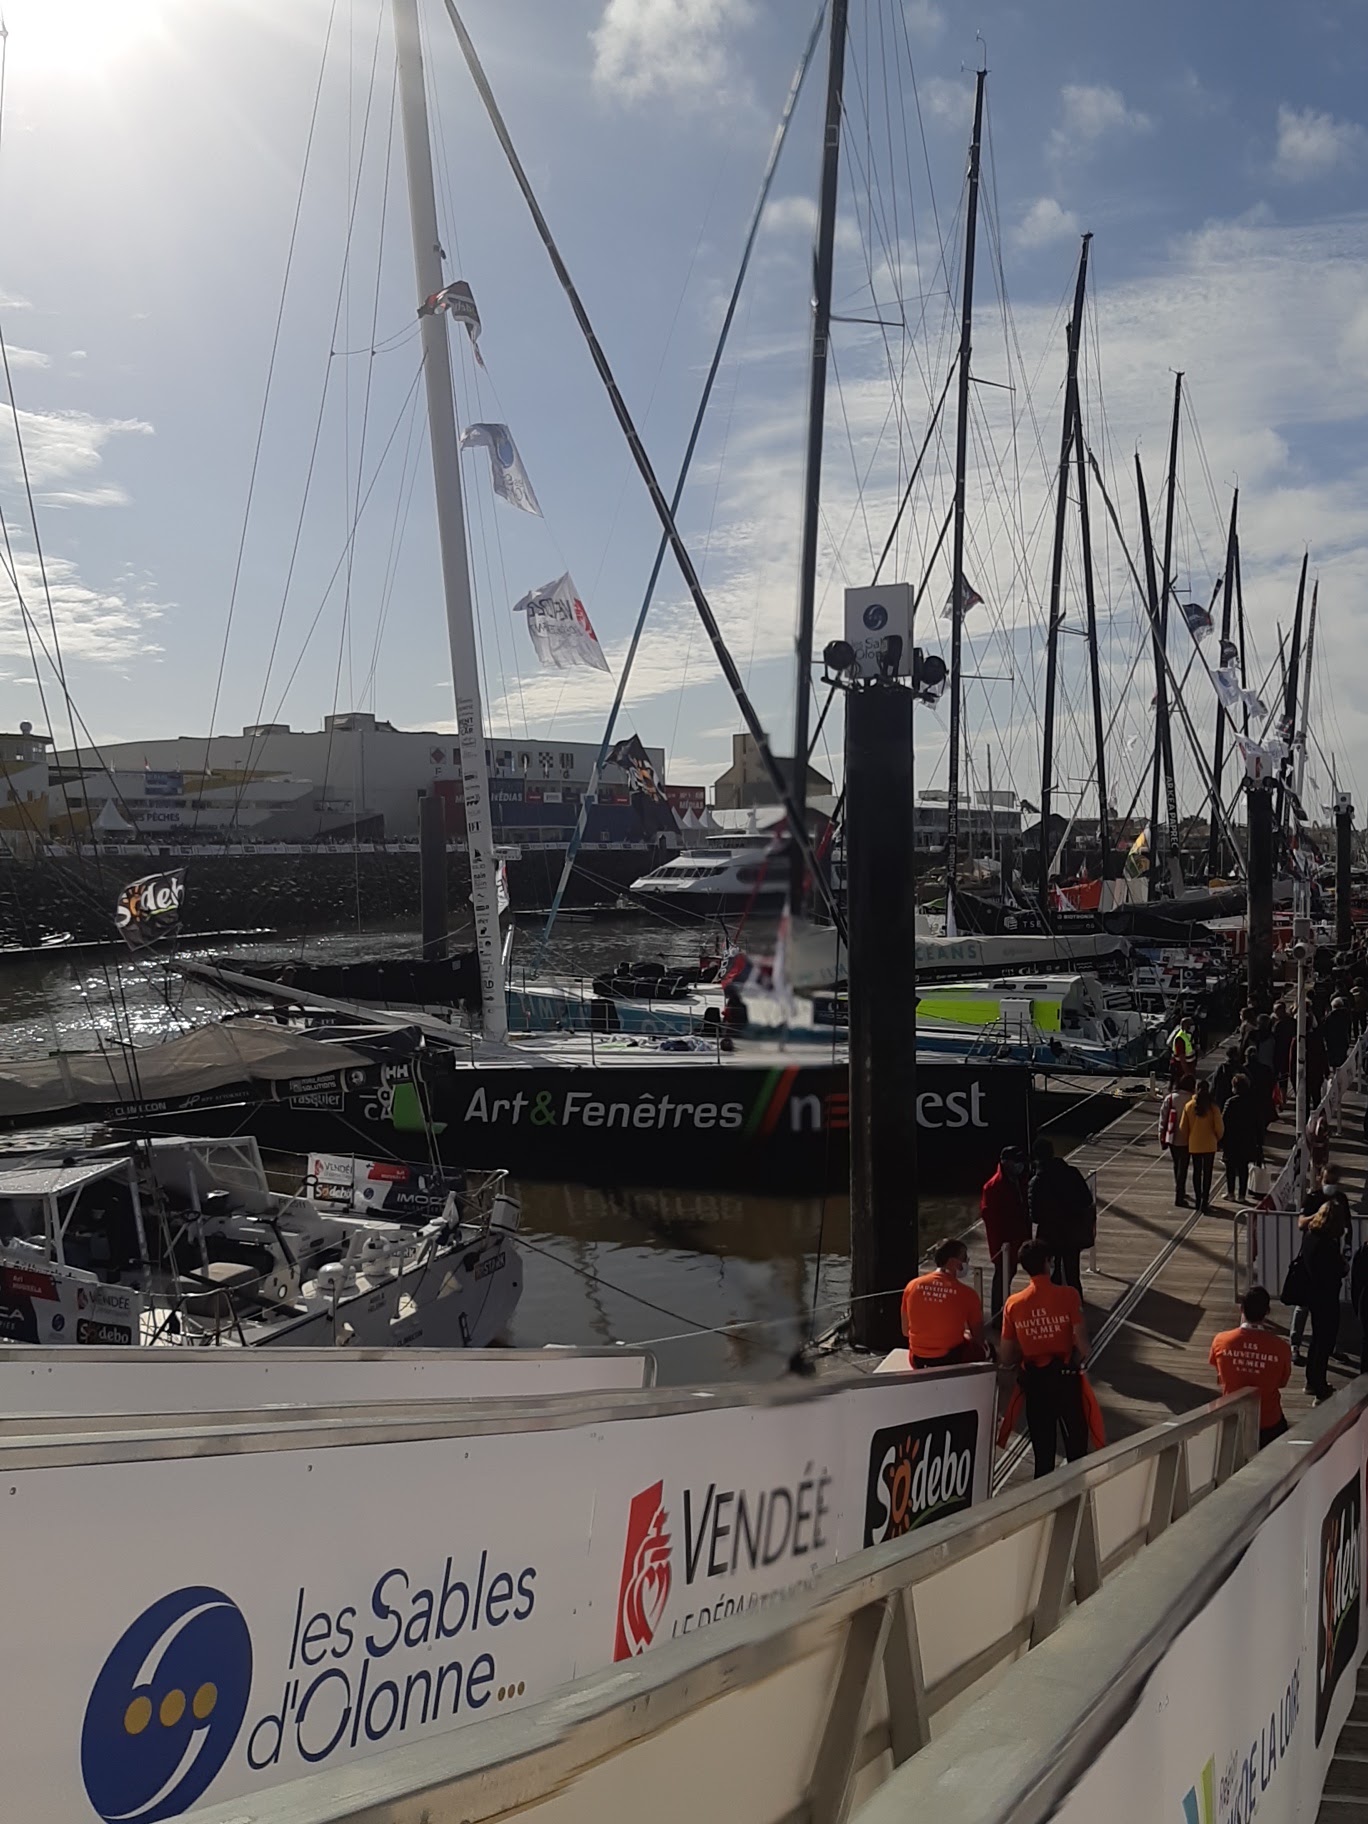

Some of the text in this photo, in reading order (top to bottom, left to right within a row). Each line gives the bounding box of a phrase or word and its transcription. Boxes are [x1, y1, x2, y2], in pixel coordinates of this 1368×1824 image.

[1031, 1307, 1047, 1318] LES
[1014, 1314, 1071, 1330] SAUVETEURS
[1040, 1325, 1062, 1335] MER
[80, 1321, 130, 1344] Sodebo
[1245, 1359, 1266, 1369] MER
[872, 1430, 972, 1545] Sodebo
[288, 1550, 537, 1670] les Sables
